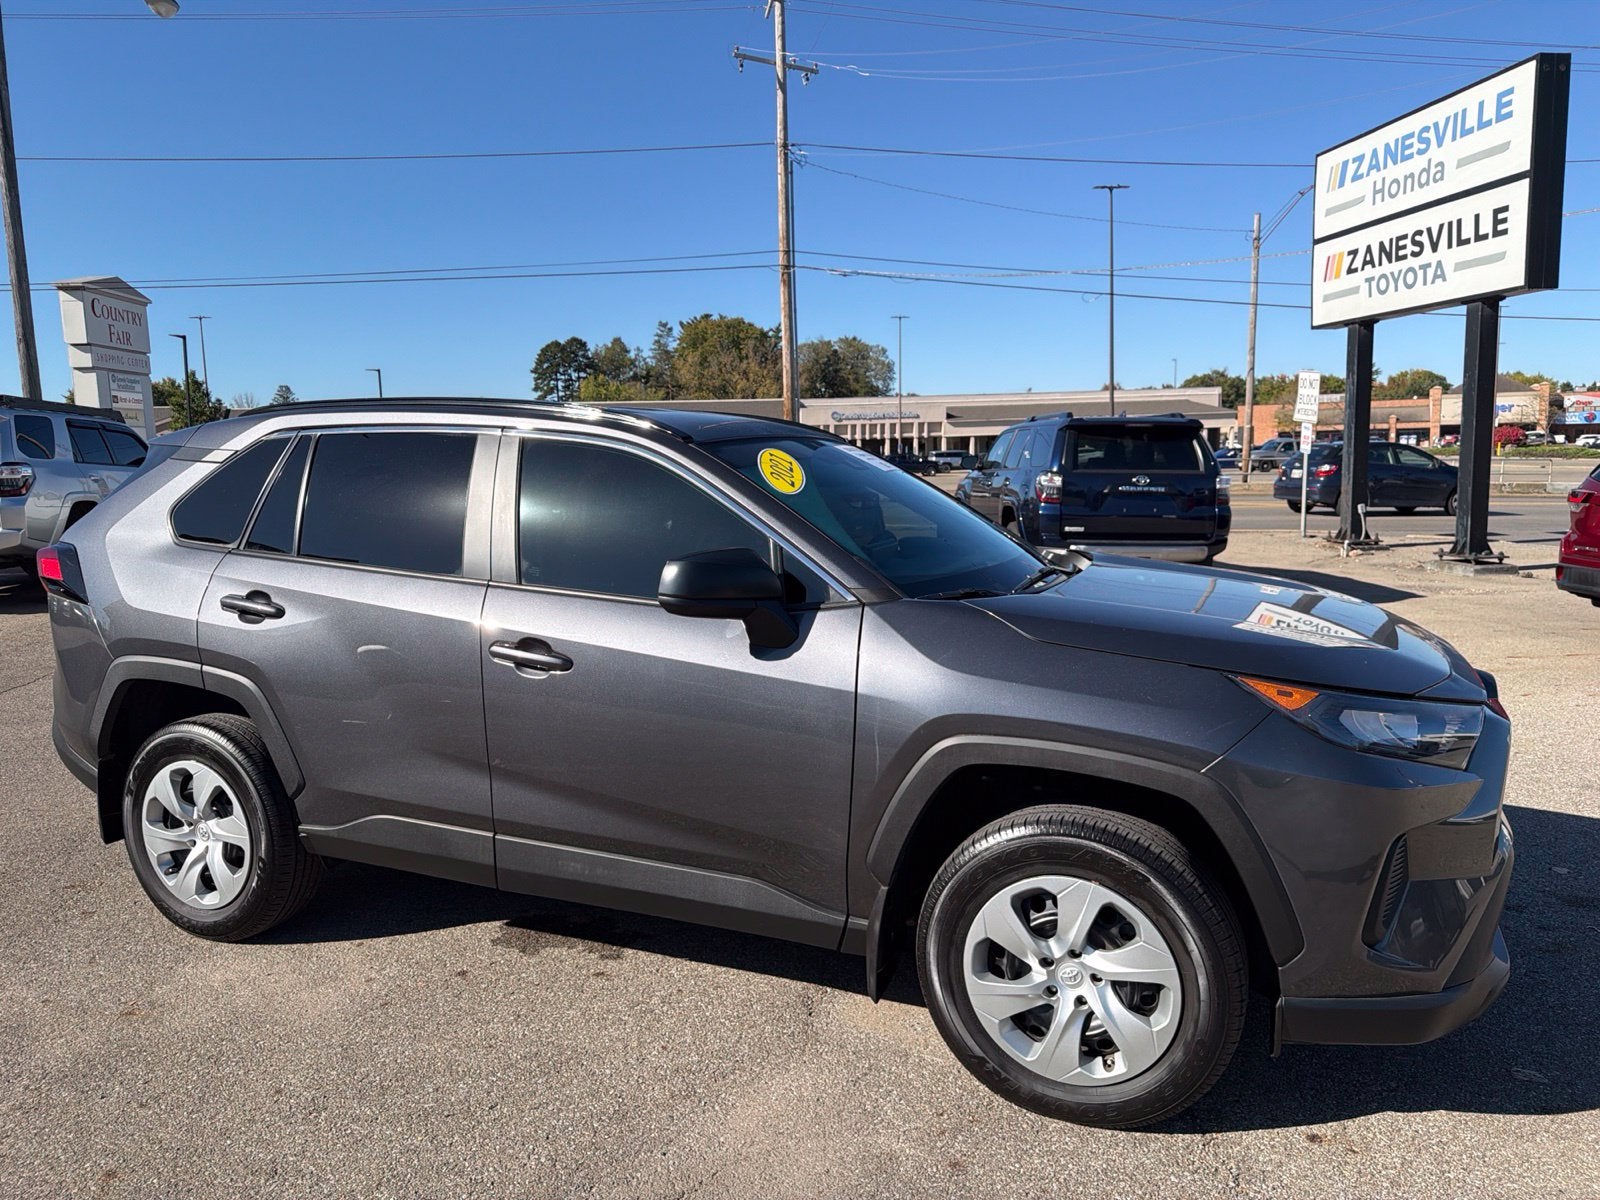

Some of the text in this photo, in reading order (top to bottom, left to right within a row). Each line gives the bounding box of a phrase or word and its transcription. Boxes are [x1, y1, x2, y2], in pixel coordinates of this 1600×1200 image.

[1350, 86, 1515, 183] ZANESVILLE
[1372, 158, 1445, 206] Honda
[1346, 204, 1510, 275] ZANESVILLE
[1364, 259, 1447, 298] TOYOTA
[96, 353, 149, 369] SHOPPING CENTER
[1299, 393, 1318, 406] BLOCK
[1300, 377, 1319, 390] DO NOT
[768, 452, 796, 489] 2021
